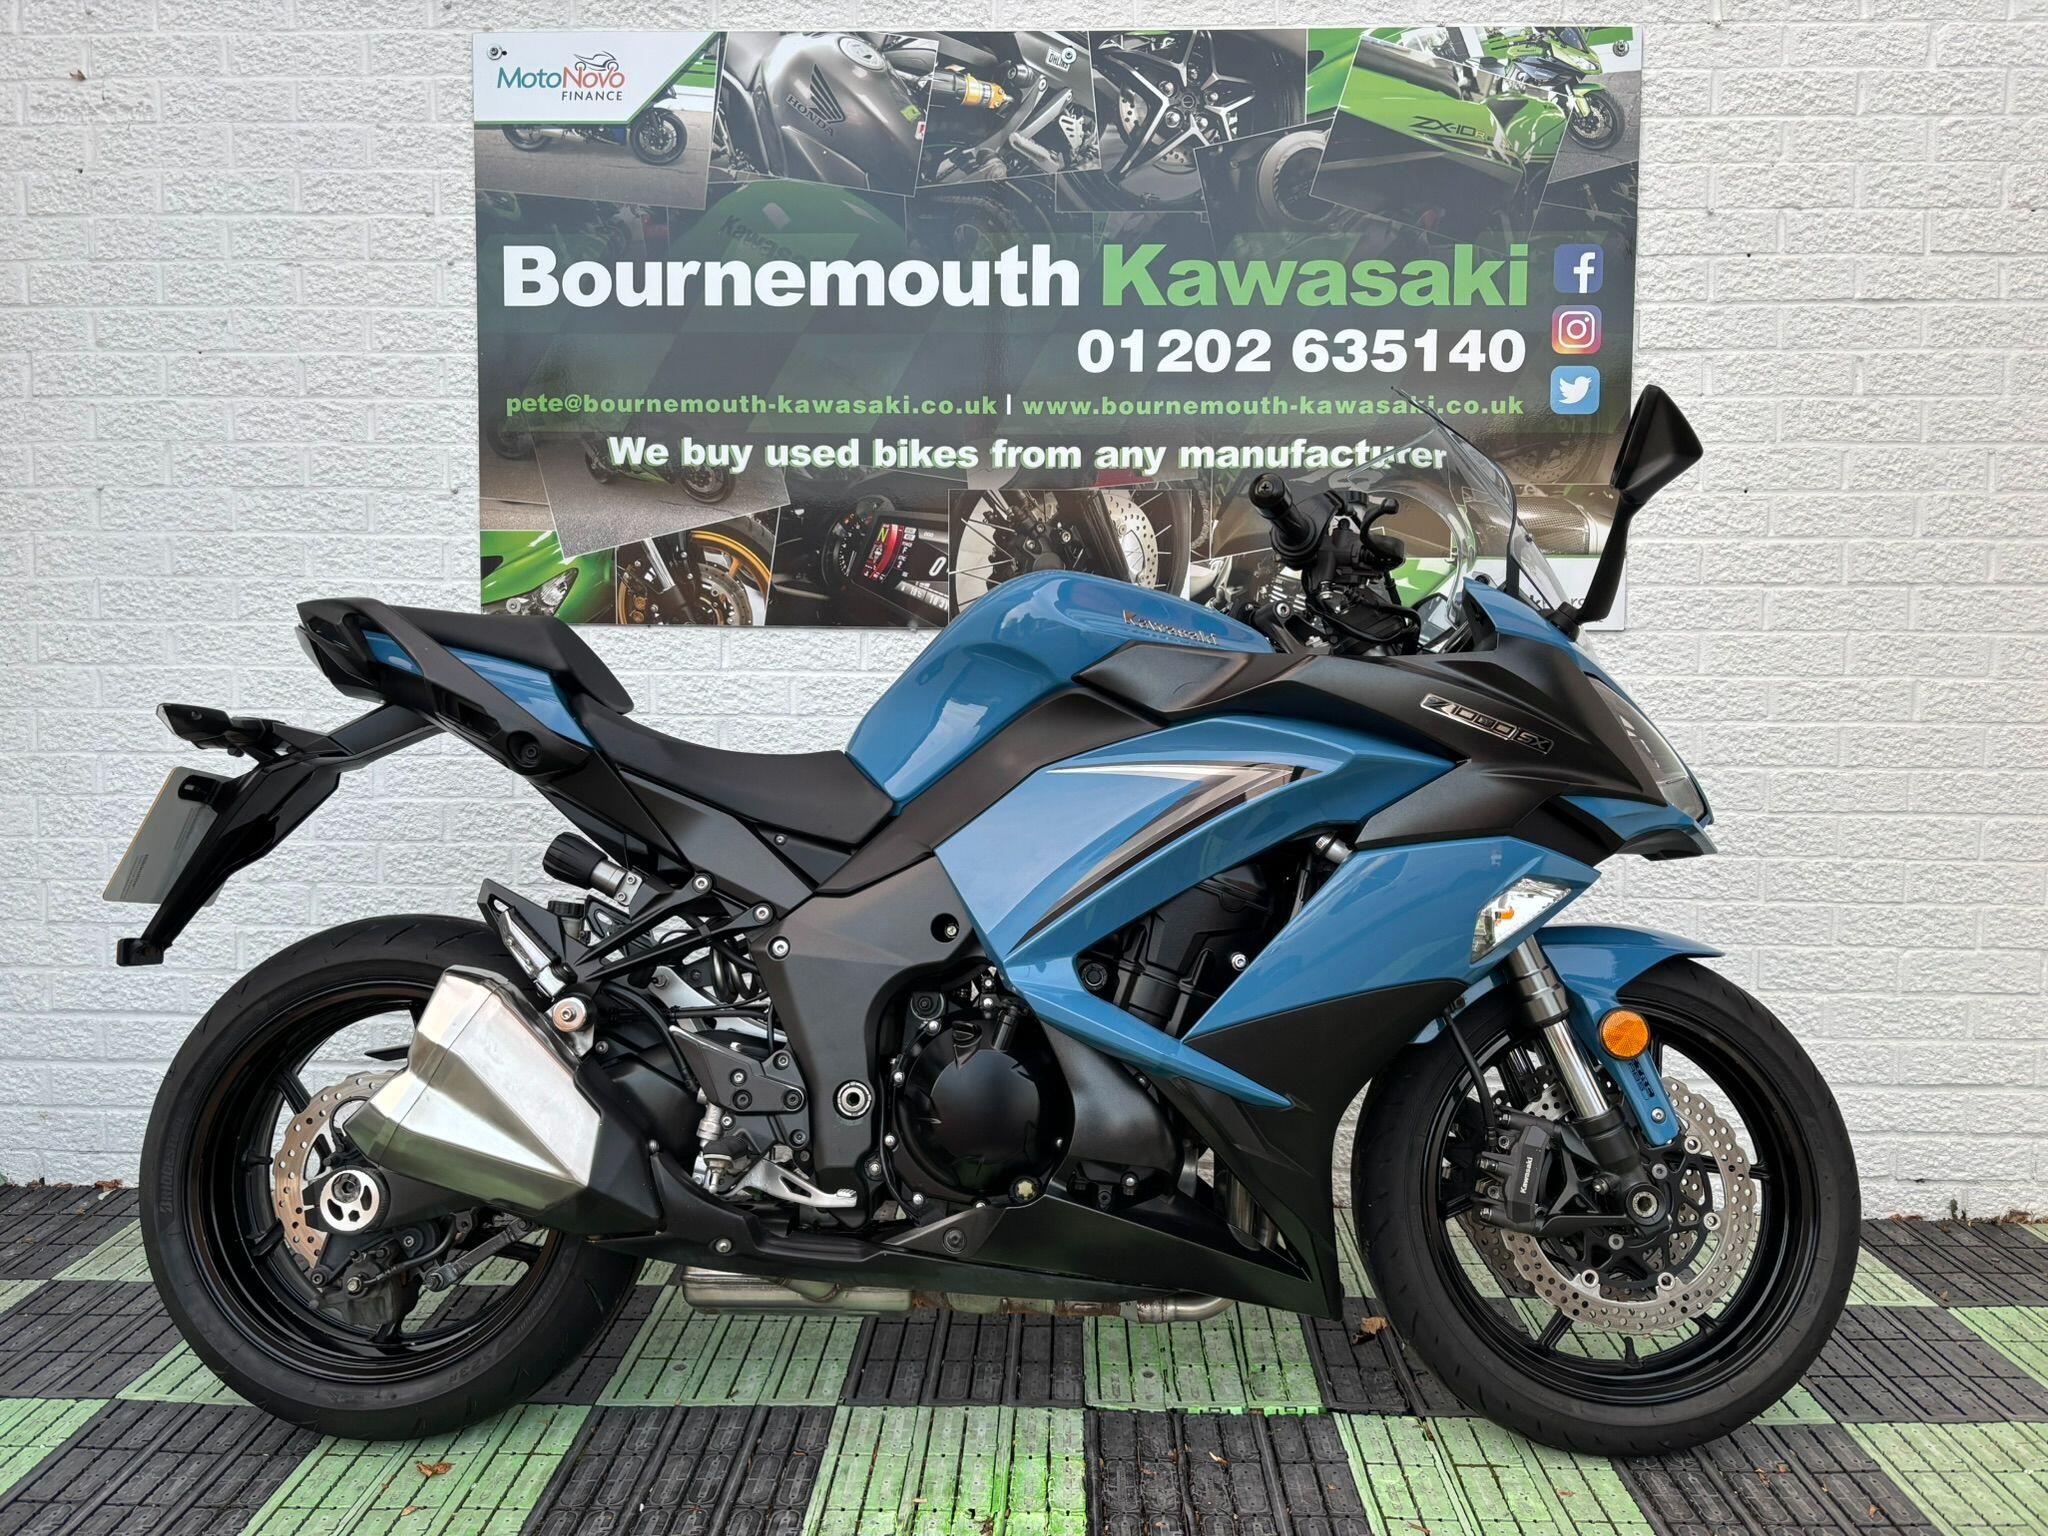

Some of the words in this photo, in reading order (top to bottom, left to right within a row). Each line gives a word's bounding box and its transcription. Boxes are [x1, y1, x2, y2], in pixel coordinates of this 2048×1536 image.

[496, 66, 625, 89] MotoNovo
[561, 90, 623, 101] FINANCE
[785, 95, 834, 137] HONDA
[502, 244, 1080, 308] Bournemouth
[1102, 243, 1530, 308] Kawasaki
[1077, 328, 1272, 374] 01202
[1291, 328, 1527, 374] 635140
[505, 393, 997, 417] pete@bournemouth-kawasaki.co.uk
[1022, 394, 1525, 417] www.bournemouth-kawasaki.co.uk
[608, 436, 669, 467] We
[682, 437, 753, 474] buy
[765, 438, 860, 468] used
[872, 438, 979, 469] bikes
[990, 438, 1082, 469] from
[1094, 445, 1168, 476] any
[1178, 438, 1448, 470] manufacturer
[1123, 609, 1217, 645] Kawasaki
[1520, 1156, 1533, 1194] Kawasaki
